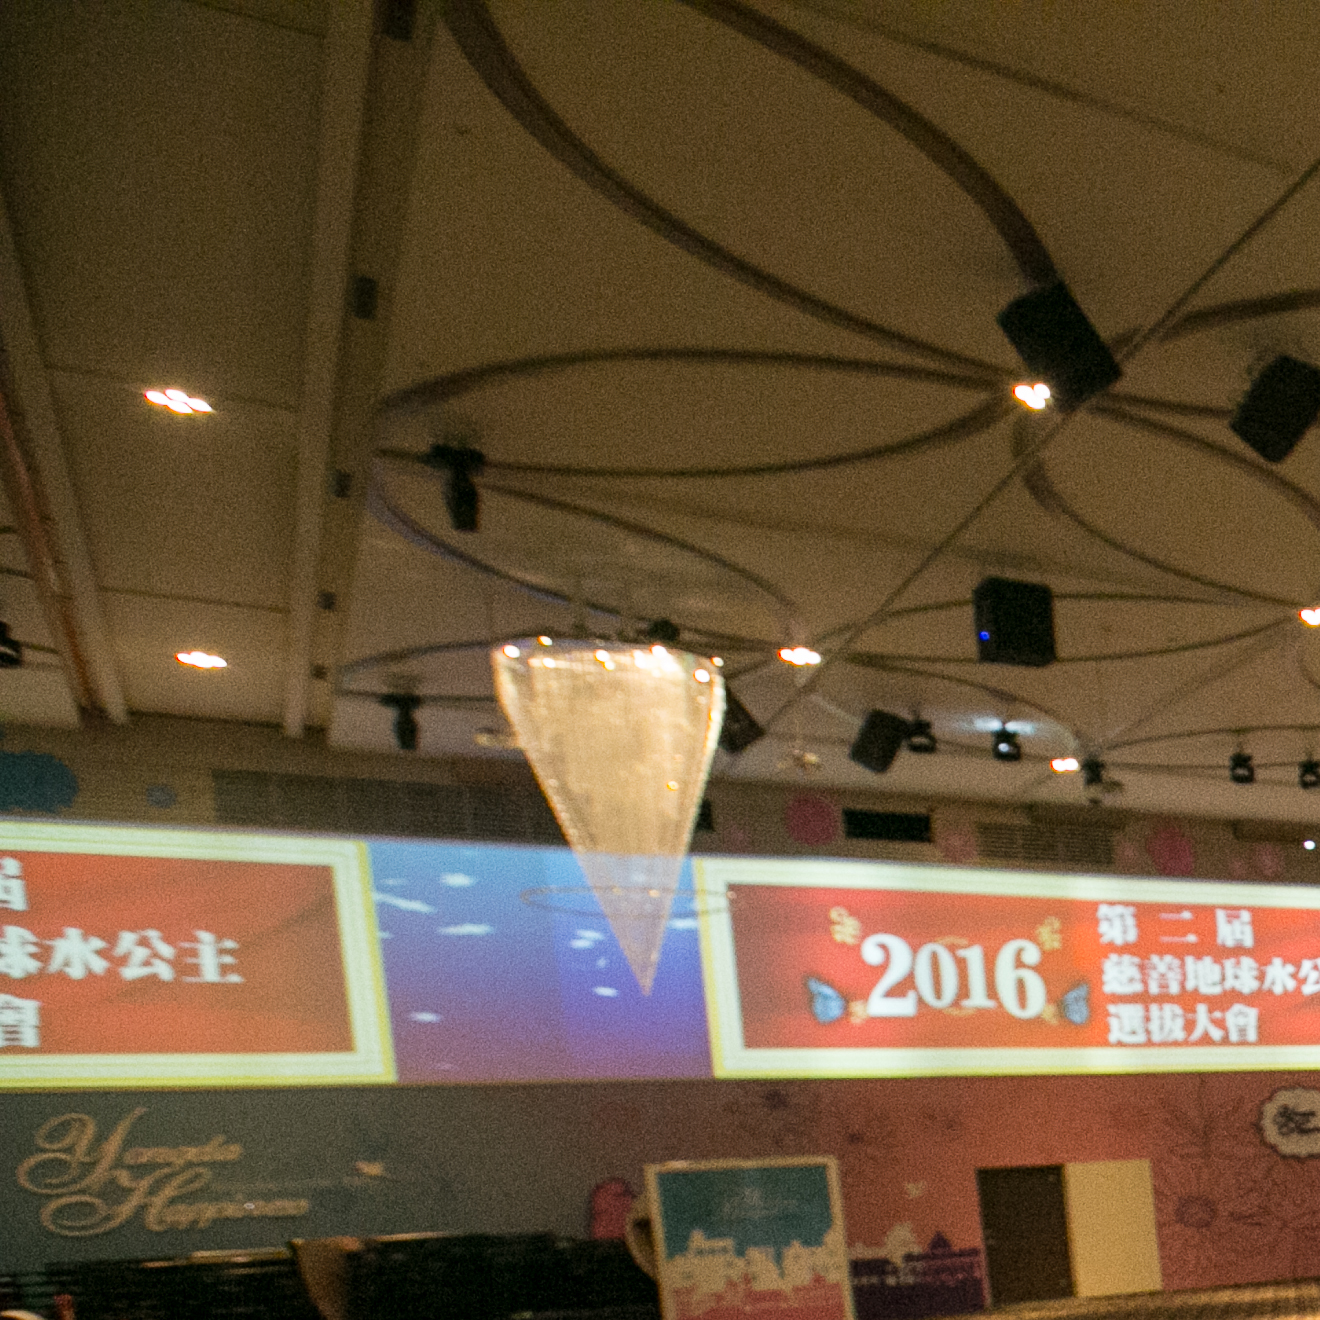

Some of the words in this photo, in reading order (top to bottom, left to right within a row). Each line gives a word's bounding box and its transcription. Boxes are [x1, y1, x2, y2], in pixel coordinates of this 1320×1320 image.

[861, 933, 1046, 1019] 2016
[1107, 1003, 1258, 1043] 選拔大會
